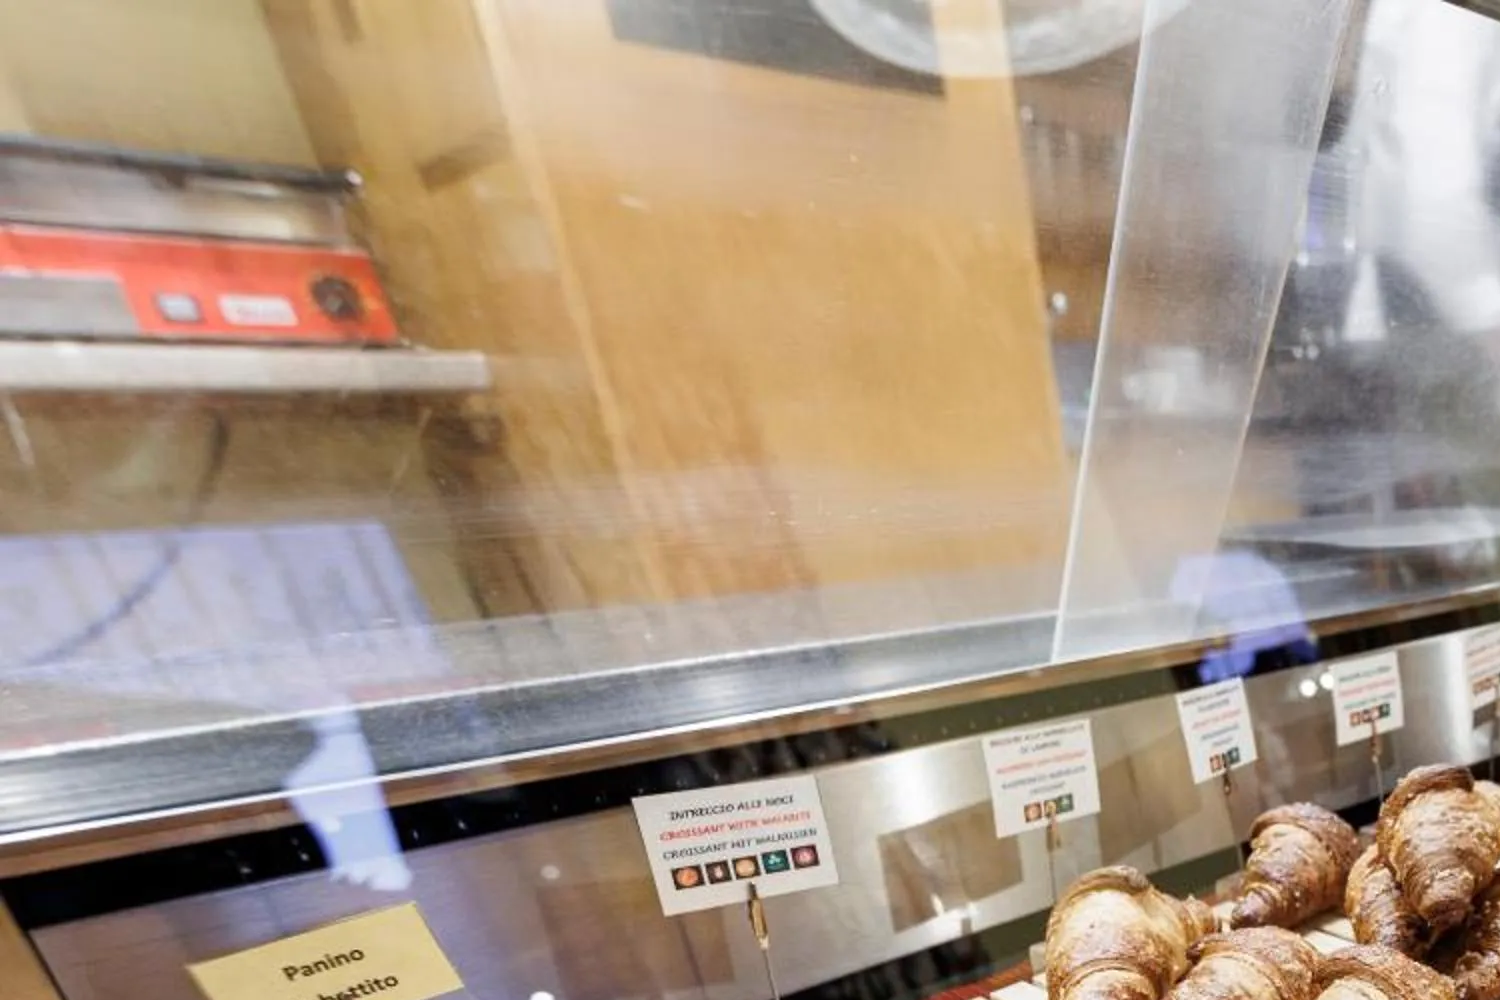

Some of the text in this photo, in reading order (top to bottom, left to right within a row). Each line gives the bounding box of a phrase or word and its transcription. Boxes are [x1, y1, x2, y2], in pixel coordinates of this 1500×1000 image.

[659, 824, 725, 841] CROISSANT
[728, 818, 759, 831] WITH
[663, 841, 728, 860] CROISSANT
[731, 835, 753, 849] MIT
[282, 948, 366, 981] Panino
